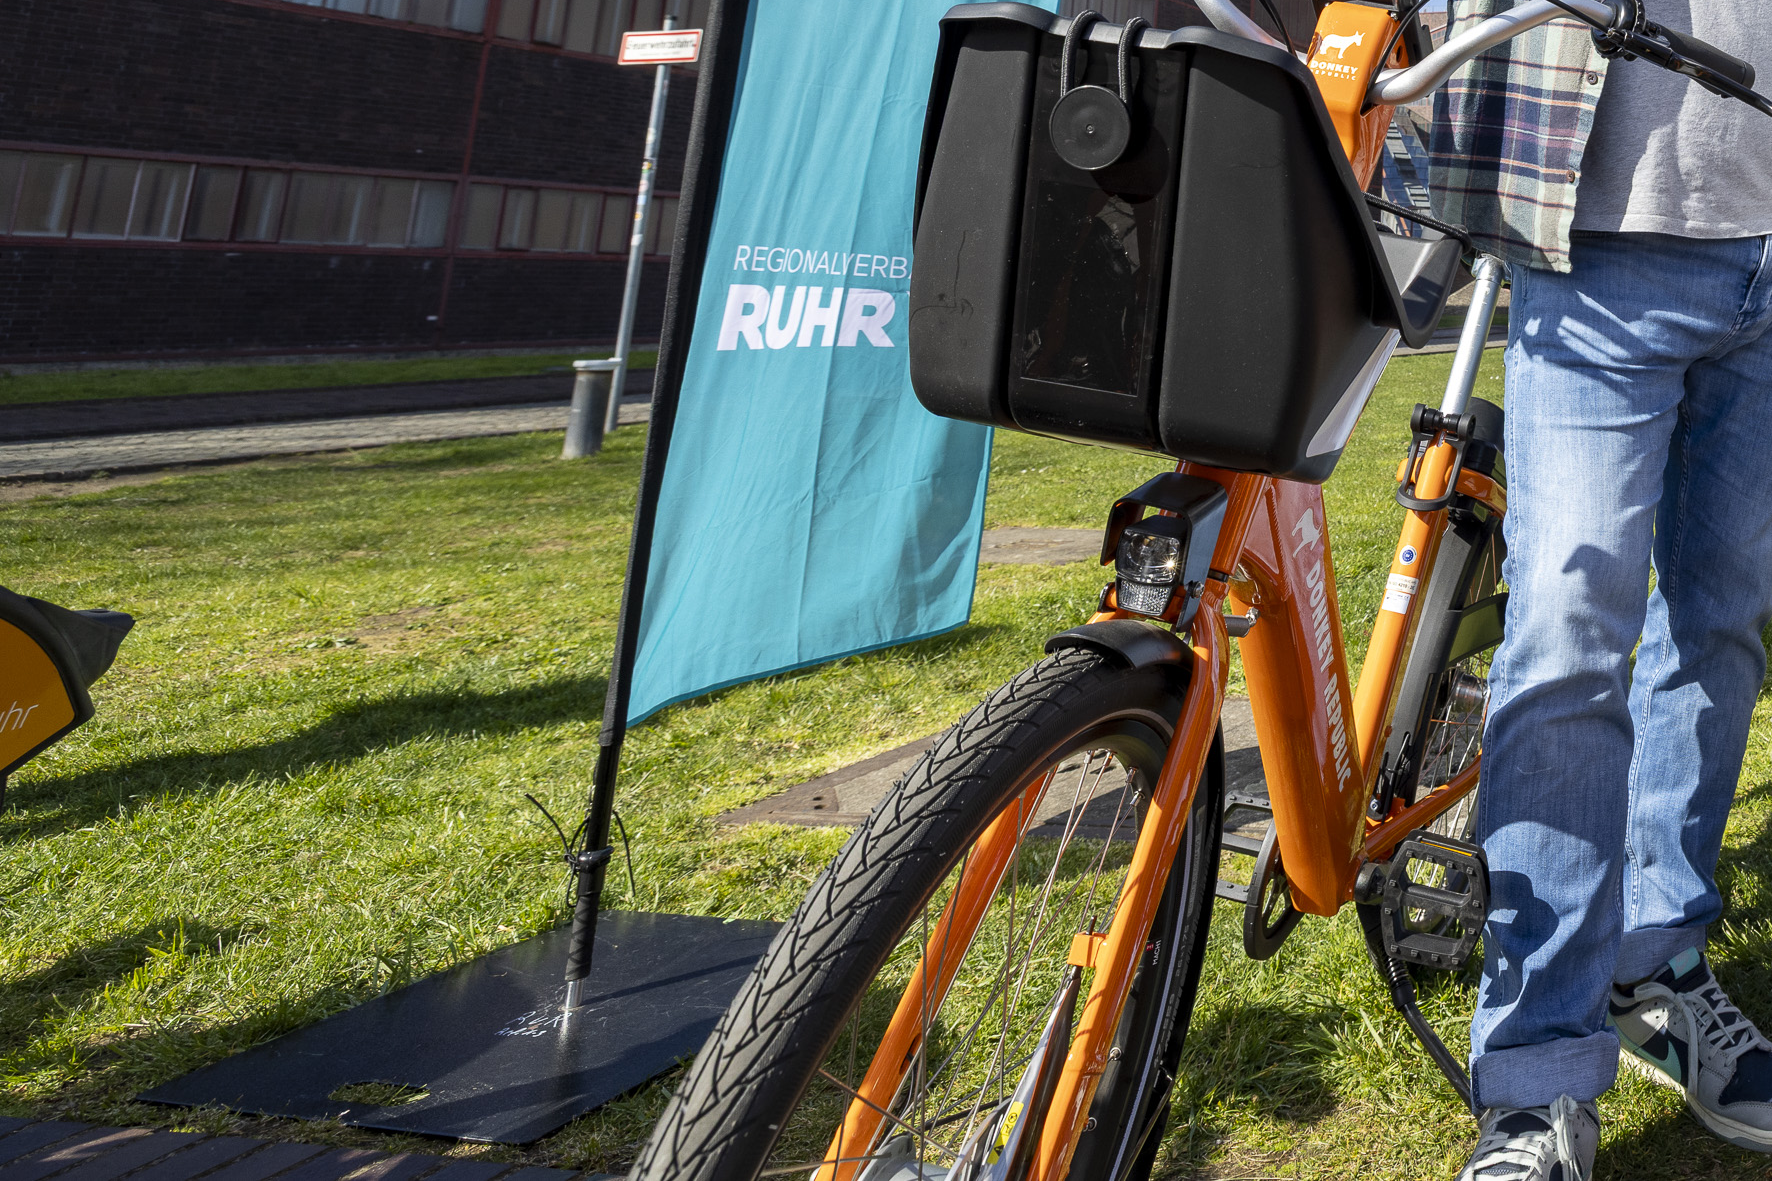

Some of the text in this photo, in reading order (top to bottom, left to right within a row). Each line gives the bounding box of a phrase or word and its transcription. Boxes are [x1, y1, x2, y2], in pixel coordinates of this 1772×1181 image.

[1310, 60, 1358, 75] DONKEY
[733, 245, 911, 279] REGIONALVERB
[717, 284, 895, 352] RUHR
[1306, 560, 1351, 793] DONKEY REPUBLIC
[0, 701, 40, 733] hr
